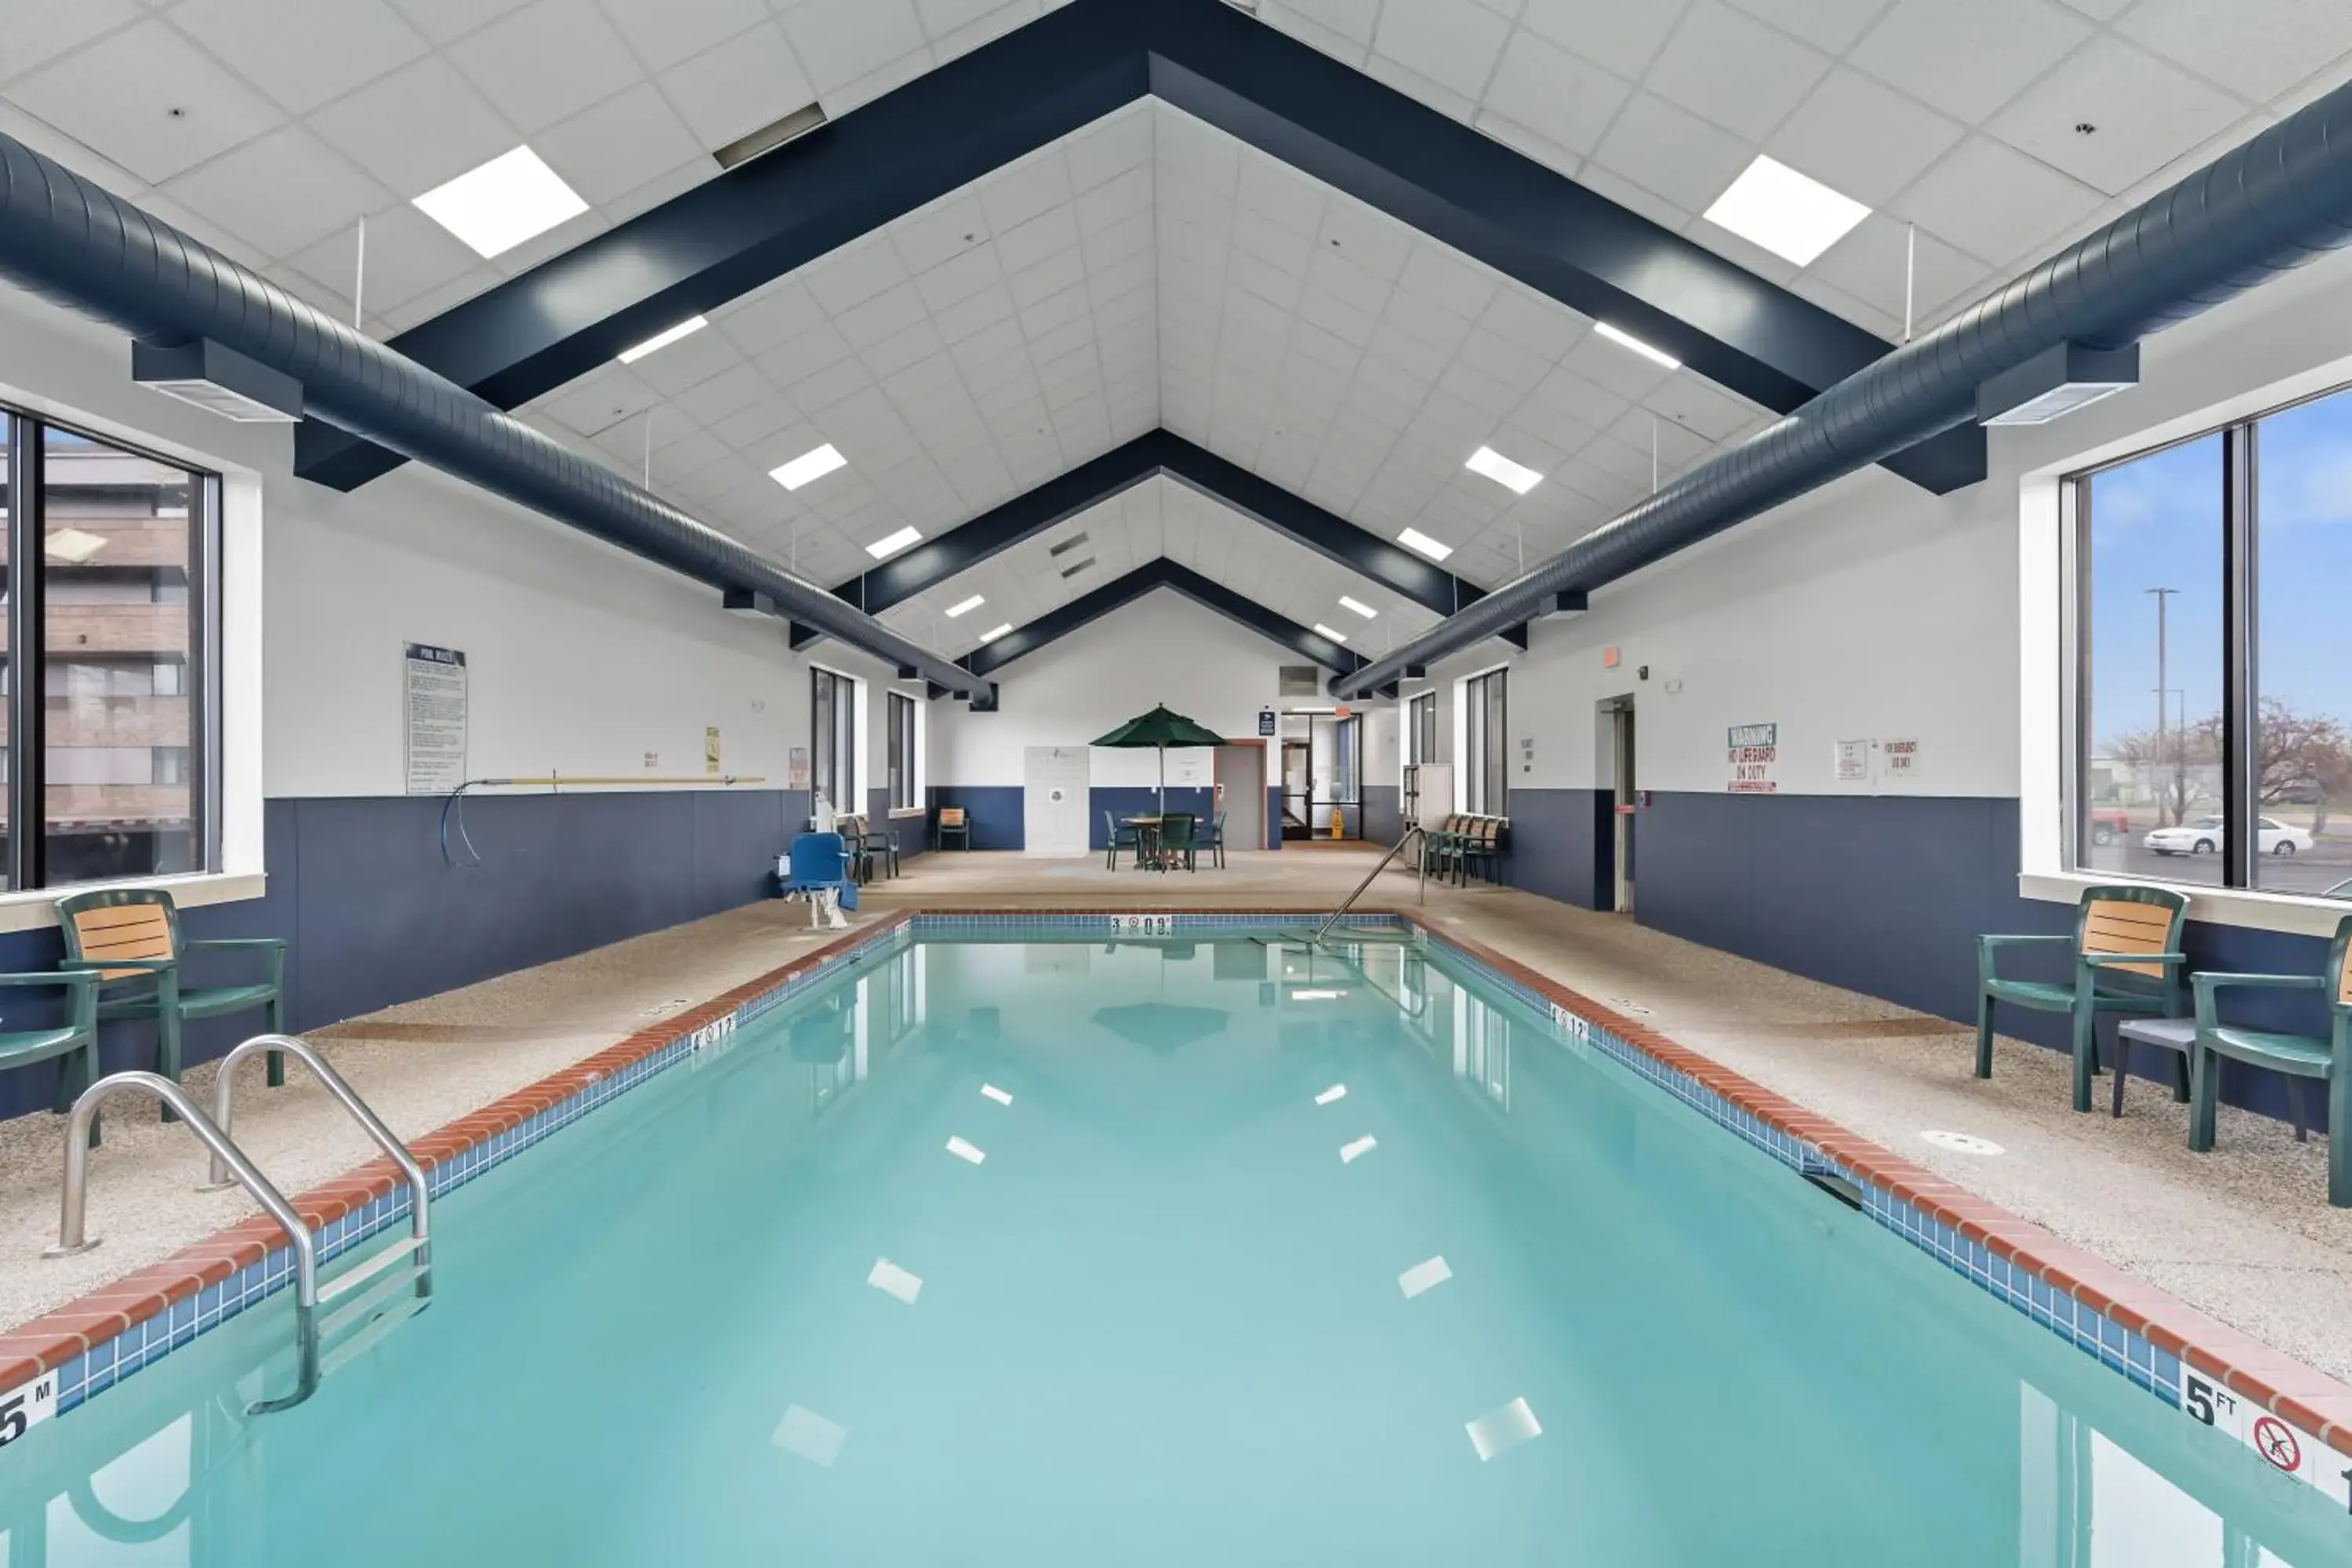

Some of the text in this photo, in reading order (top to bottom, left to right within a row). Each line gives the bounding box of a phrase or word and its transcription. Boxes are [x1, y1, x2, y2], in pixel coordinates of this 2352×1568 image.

[1730, 725, 1773, 746] WARNING
[1729, 746, 1776, 763] NO LIFEGUARD
[1737, 764, 1766, 780] ON DUTY
[2187, 1374, 2214, 1426] 5
[2216, 1392, 2237, 1415] FT
[0, 1381, 50, 1448] 5 M
